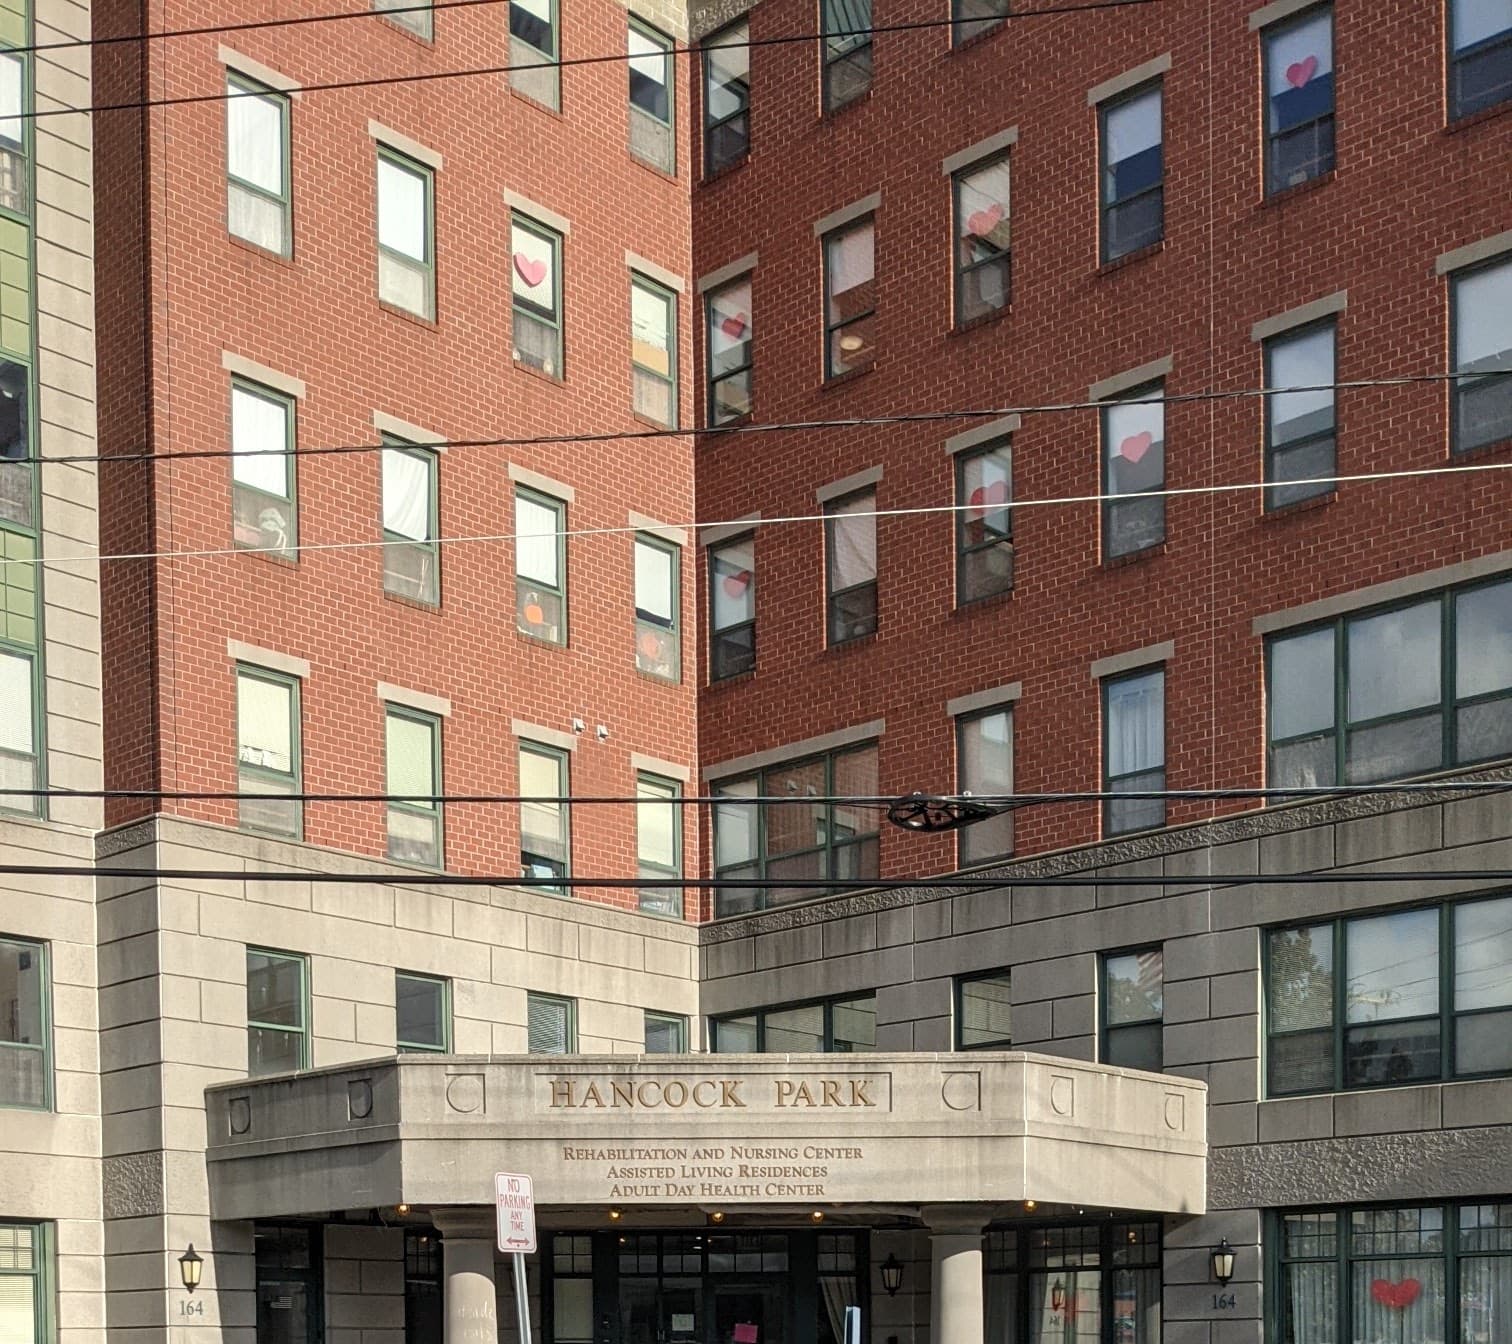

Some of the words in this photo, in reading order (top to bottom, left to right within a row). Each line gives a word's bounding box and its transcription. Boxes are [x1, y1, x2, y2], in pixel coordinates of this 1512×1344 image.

[549, 1080, 747, 1108] HANCOCK
[774, 1080, 877, 1107] PARK
[563, 1147, 687, 1160] REHABILITATION
[692, 1148, 725, 1160] AND
[730, 1146, 798, 1160] NURSING
[803, 1146, 863, 1159] CENTER
[607, 1165, 675, 1178] ASSISTED
[680, 1165, 733, 1178] LIVING
[738, 1164, 828, 1178] RESIDENCES
[507, 1178, 521, 1193] NO
[610, 1183, 660, 1197] ADULT
[665, 1183, 696, 1197] DAY
[700, 1183, 760, 1197] HEALTH
[765, 1182, 825, 1196] CENTER
[499, 1193, 531, 1209] PARKING
[510, 1210, 523, 1220] ANY
[510, 1220, 525, 1232] TIME
[179, 1300, 203, 1316] 164
[1213, 1294, 1236, 1309] 164
